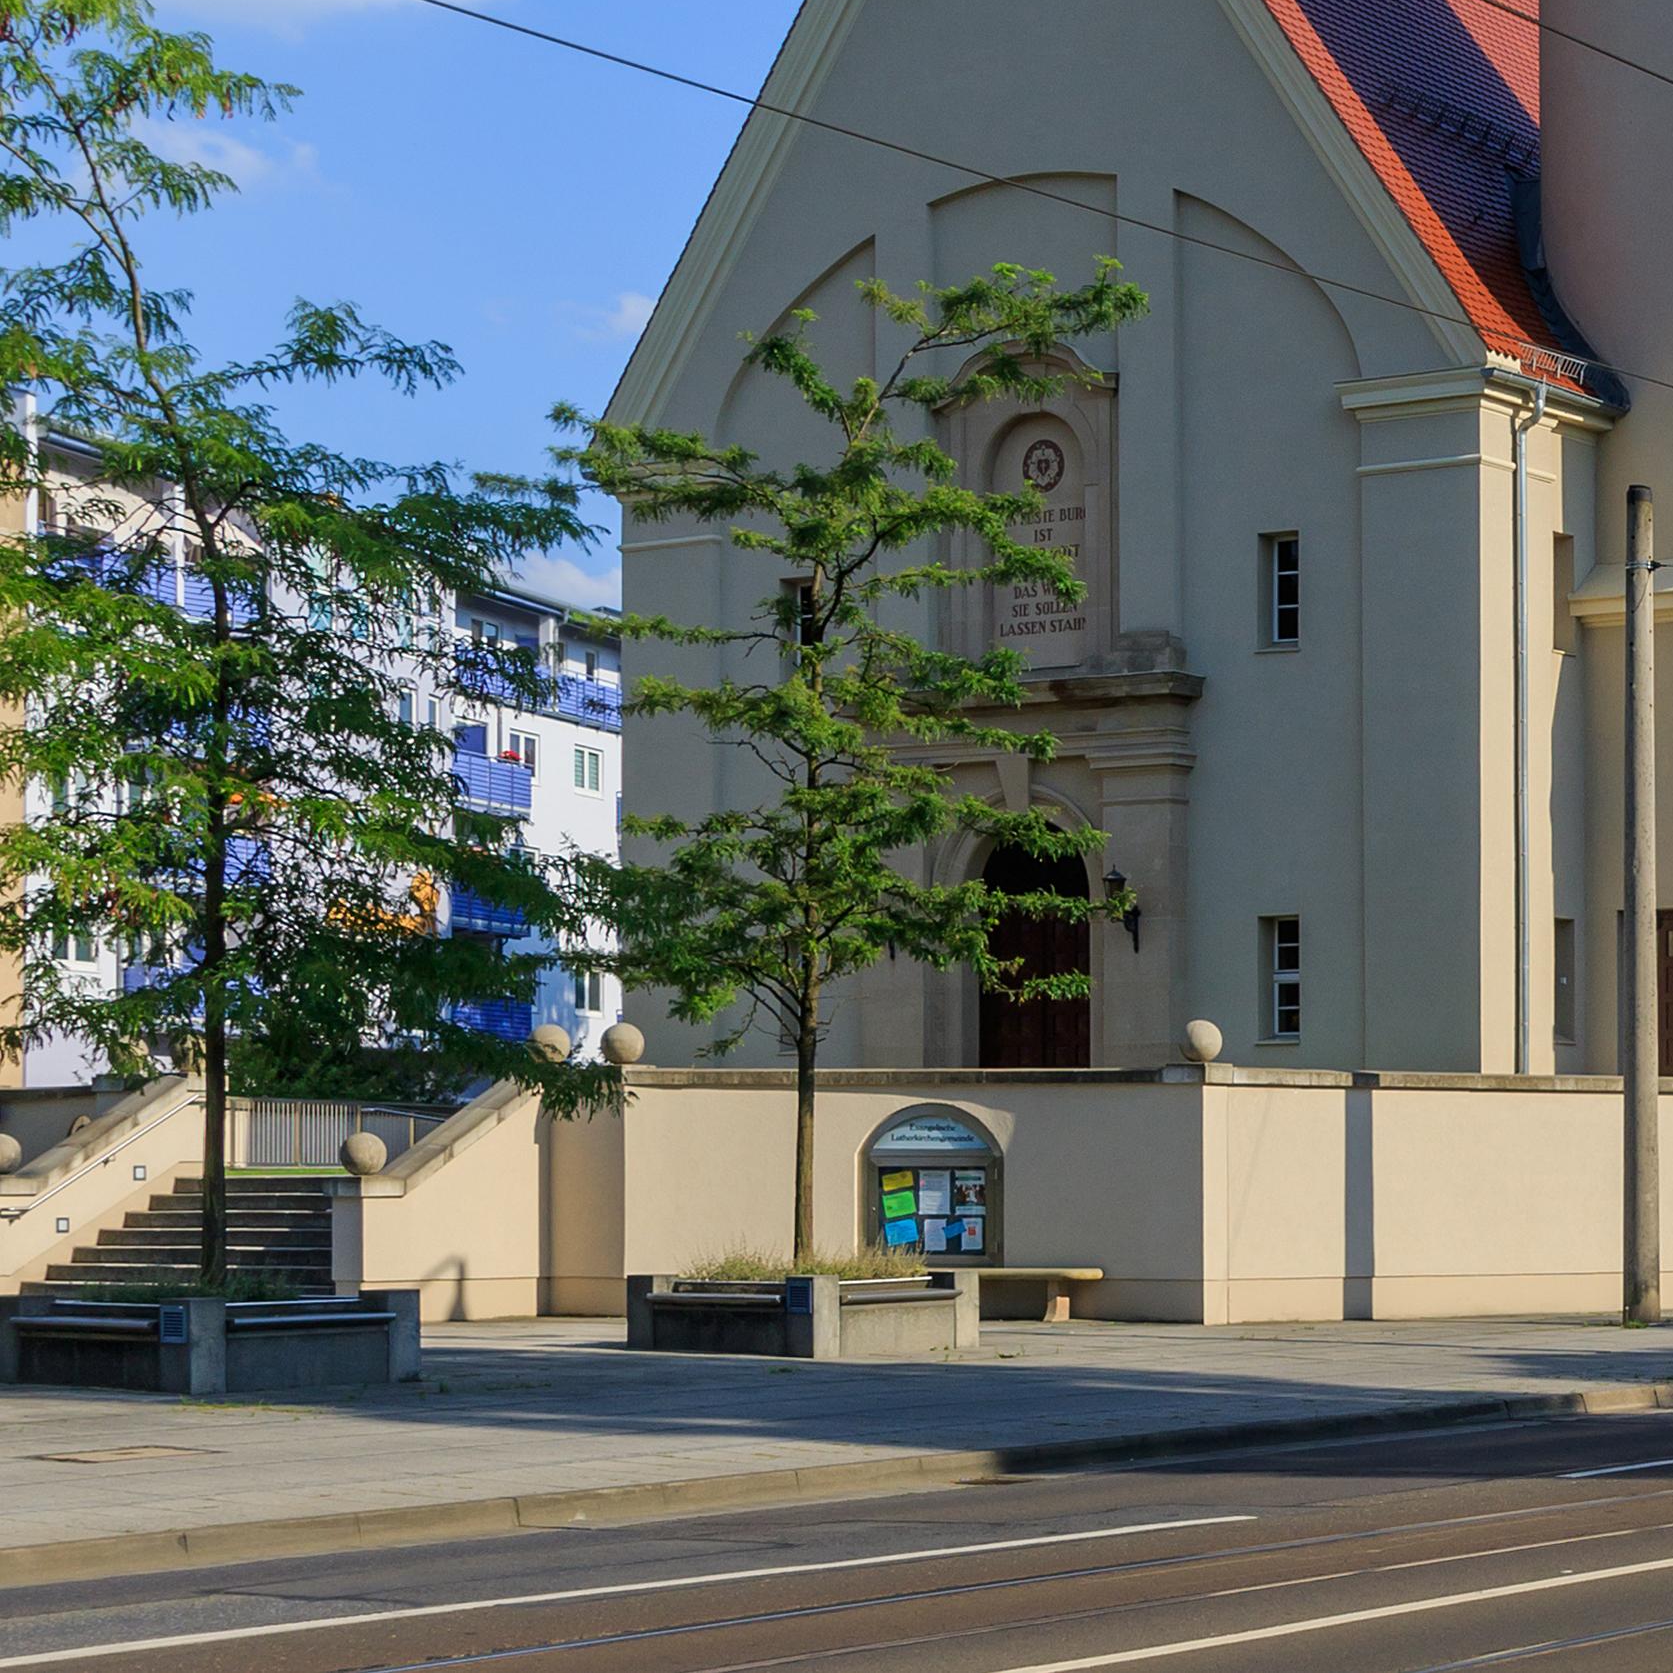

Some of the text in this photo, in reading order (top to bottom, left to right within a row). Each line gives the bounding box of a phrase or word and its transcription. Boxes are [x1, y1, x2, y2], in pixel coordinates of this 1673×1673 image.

[1034, 528, 1053, 543] IST
[1014, 584, 1037, 599] DAS
[1012, 603, 1030, 618] SIE
[1000, 620, 1046, 637] LASSEN
